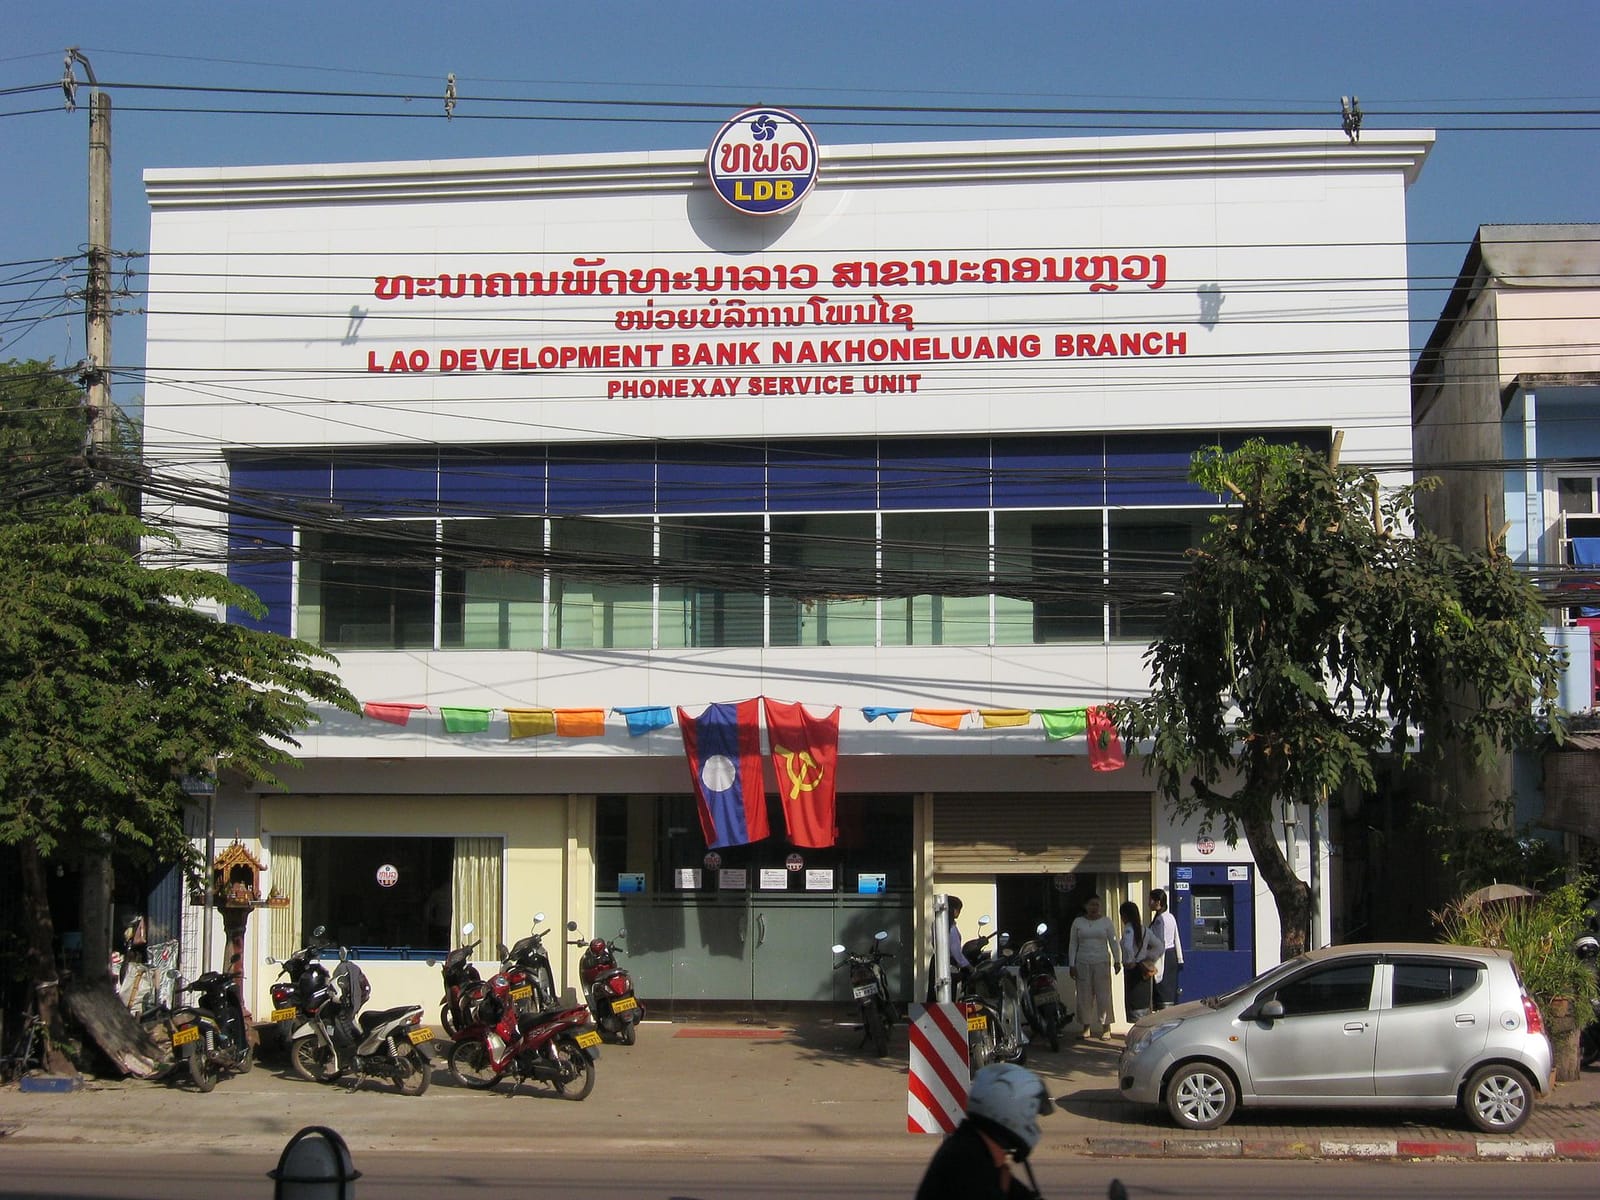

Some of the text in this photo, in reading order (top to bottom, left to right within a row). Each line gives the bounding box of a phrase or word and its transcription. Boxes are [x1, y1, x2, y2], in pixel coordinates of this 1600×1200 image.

[720, 142, 808, 173] ທພລ
[734, 180, 795, 201] LDB
[375, 258, 819, 301] ທະນາຄານພັດທະນາລາວ
[368, 331, 1188, 373] LAO DEVELOPMENT BANK NAKHONELUANG BRANCH
[608, 371, 922, 399] PHONEXAY SERVICE UNIT
